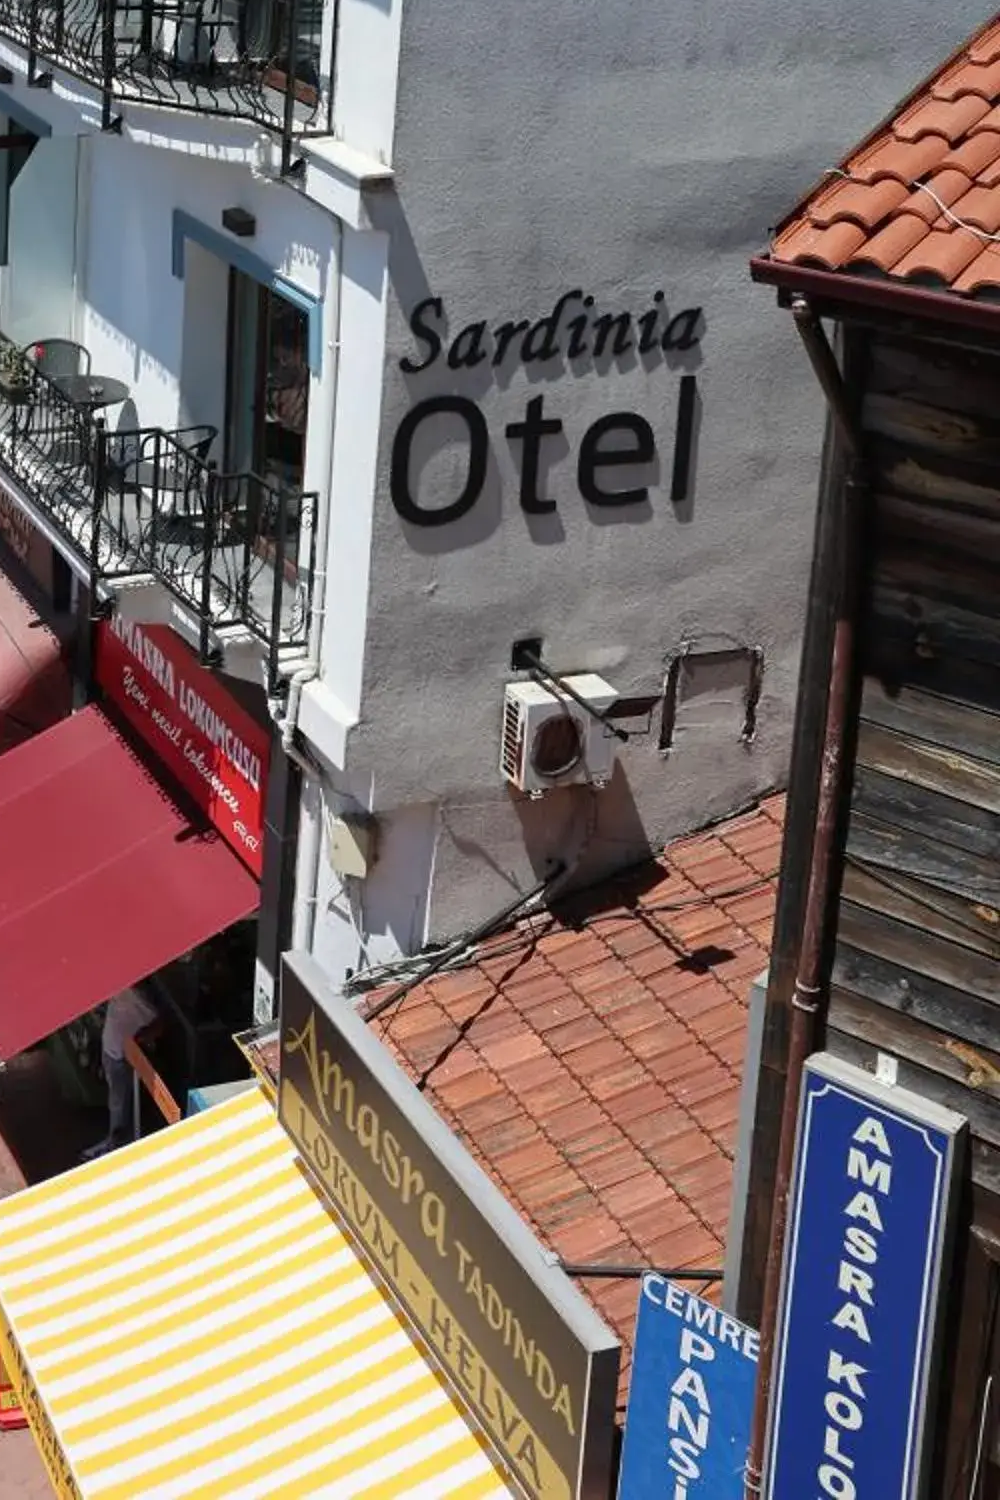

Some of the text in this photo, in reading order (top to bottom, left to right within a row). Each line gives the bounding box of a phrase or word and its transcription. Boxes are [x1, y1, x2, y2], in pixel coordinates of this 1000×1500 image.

[400, 290, 702, 373] Sardinia
[390, 376, 697, 527] Otel
[109, 611, 261, 792] AMASRA LOKUMCUSU
[285, 1005, 576, 1435] Amasra TADINDA
[298, 1103, 403, 1279] LOKUM
[428, 1296, 543, 1491] HELVA
[817, 1116, 893, 1500] AMASRA KOLO
[643, 1274, 761, 1363] CEMRE
